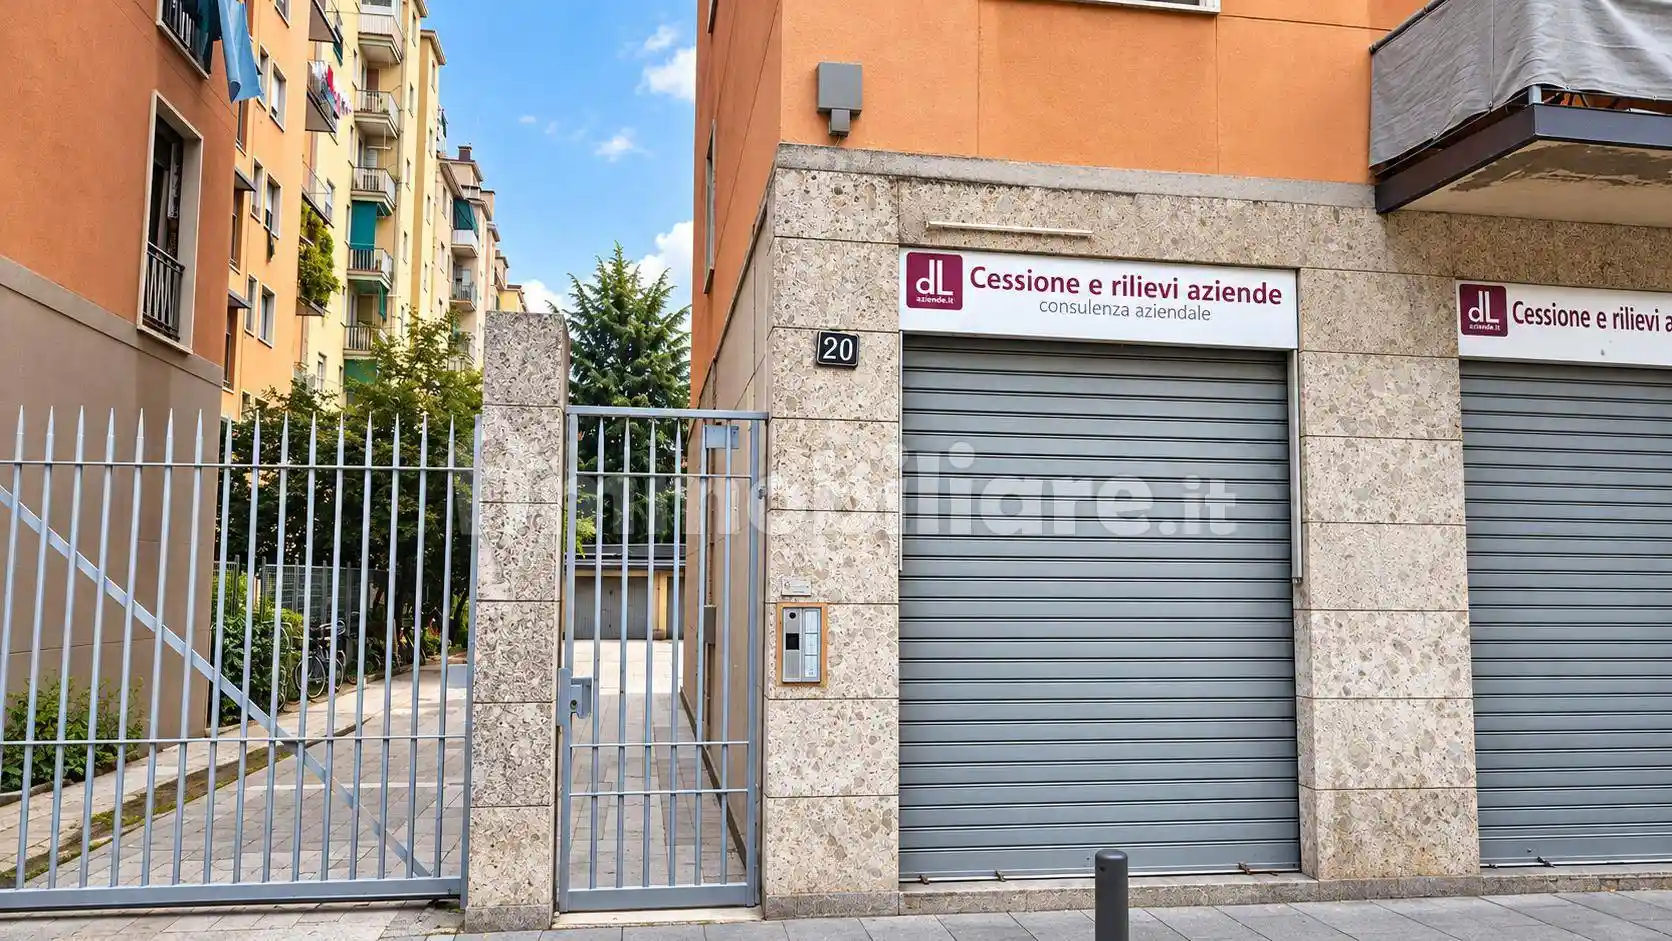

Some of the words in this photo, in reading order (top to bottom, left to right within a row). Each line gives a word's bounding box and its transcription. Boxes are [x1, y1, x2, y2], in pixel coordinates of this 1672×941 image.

[970, 266, 1080, 294] Cessione
[1088, 278, 1103, 296] e
[1111, 274, 1178, 300] rilievi
[1187, 281, 1282, 306] aziende
[1039, 299, 1130, 317] consulenza
[1135, 302, 1212, 321] aziendale
[1512, 300, 1591, 328] Cessione
[1596, 311, 1607, 330] e
[1612, 306, 1660, 332] rilievi
[823, 336, 853, 361] 20
